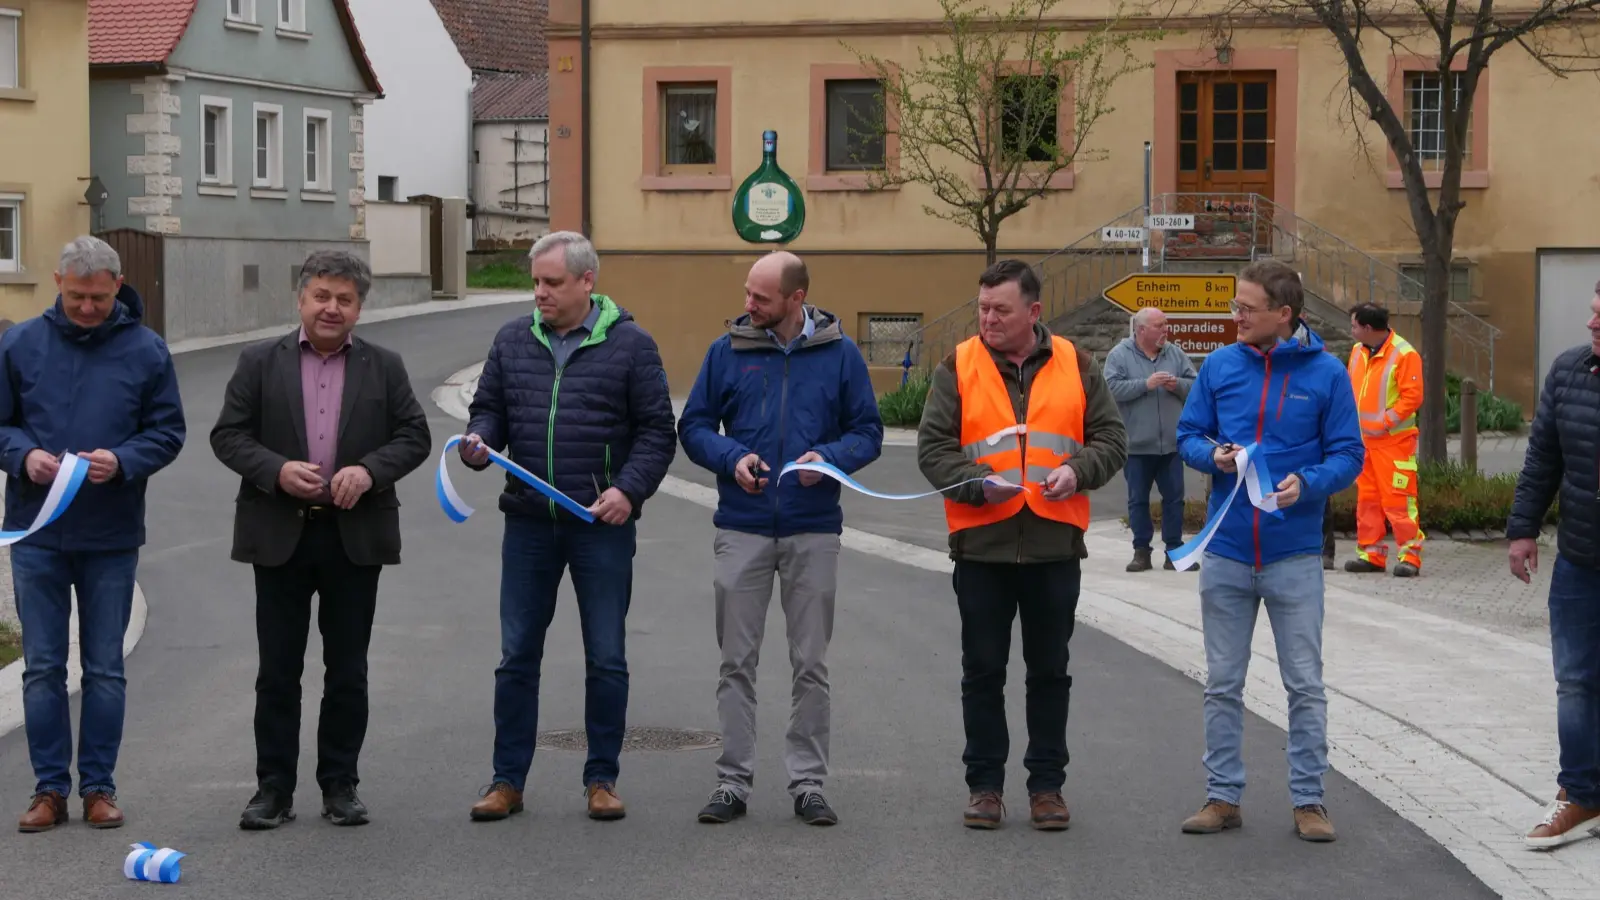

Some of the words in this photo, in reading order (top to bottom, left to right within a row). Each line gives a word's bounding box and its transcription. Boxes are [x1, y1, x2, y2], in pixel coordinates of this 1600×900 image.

[1152, 217, 1182, 226] 150-260
[1114, 229, 1140, 238] 40-142
[1136, 281, 1181, 292] Enheim
[1205, 281, 1213, 292] 8
[1215, 284, 1229, 292] km
[1136, 296, 1200, 308] Gnötzheim
[1205, 297, 1213, 308] 4
[1215, 299, 1229, 308] km
[1166, 321, 1225, 335] nparadies
